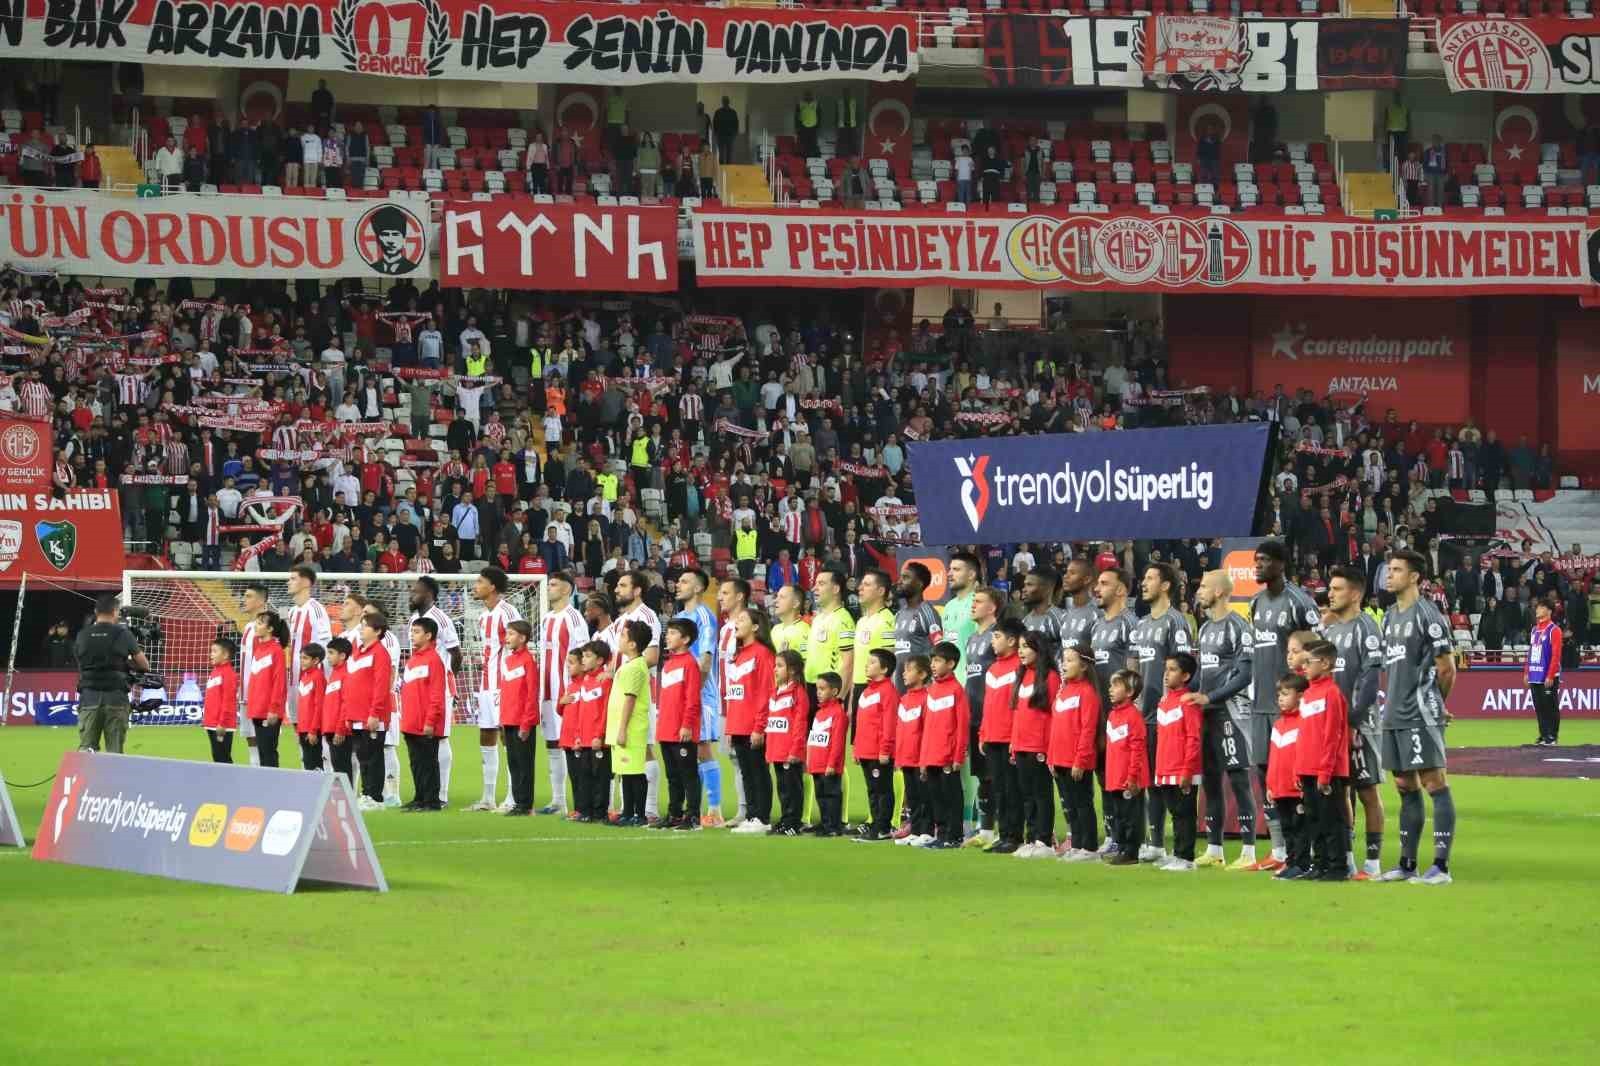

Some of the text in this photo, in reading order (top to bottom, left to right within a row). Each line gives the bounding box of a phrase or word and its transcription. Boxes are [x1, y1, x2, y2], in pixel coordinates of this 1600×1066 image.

[43, 0, 127, 48] BAK
[147, 0, 320, 60] ARKANA
[354, 2, 427, 58] 07
[461, 6, 907, 75] HEP SENİN YANINDA
[1446, 21, 1538, 63] ANTALYASPOR
[101, 209, 344, 270] ORDUSU
[703, 220, 1002, 275] HEP PEŞİNDEYİZ
[1258, 225, 1582, 282] HİÇ DÜŞÜNMEDEN
[1303, 335, 1454, 362] corendon park
[1328, 376, 1398, 394] ANTALYA
[35, 489, 111, 510] SAHİBİ
[994, 460, 1111, 513] trendyol
[1255, 628, 1277, 641] beko
[1222, 737, 1236, 757] 18
[1411, 733, 1422, 754] 3
[77, 788, 142, 832] trendyol
